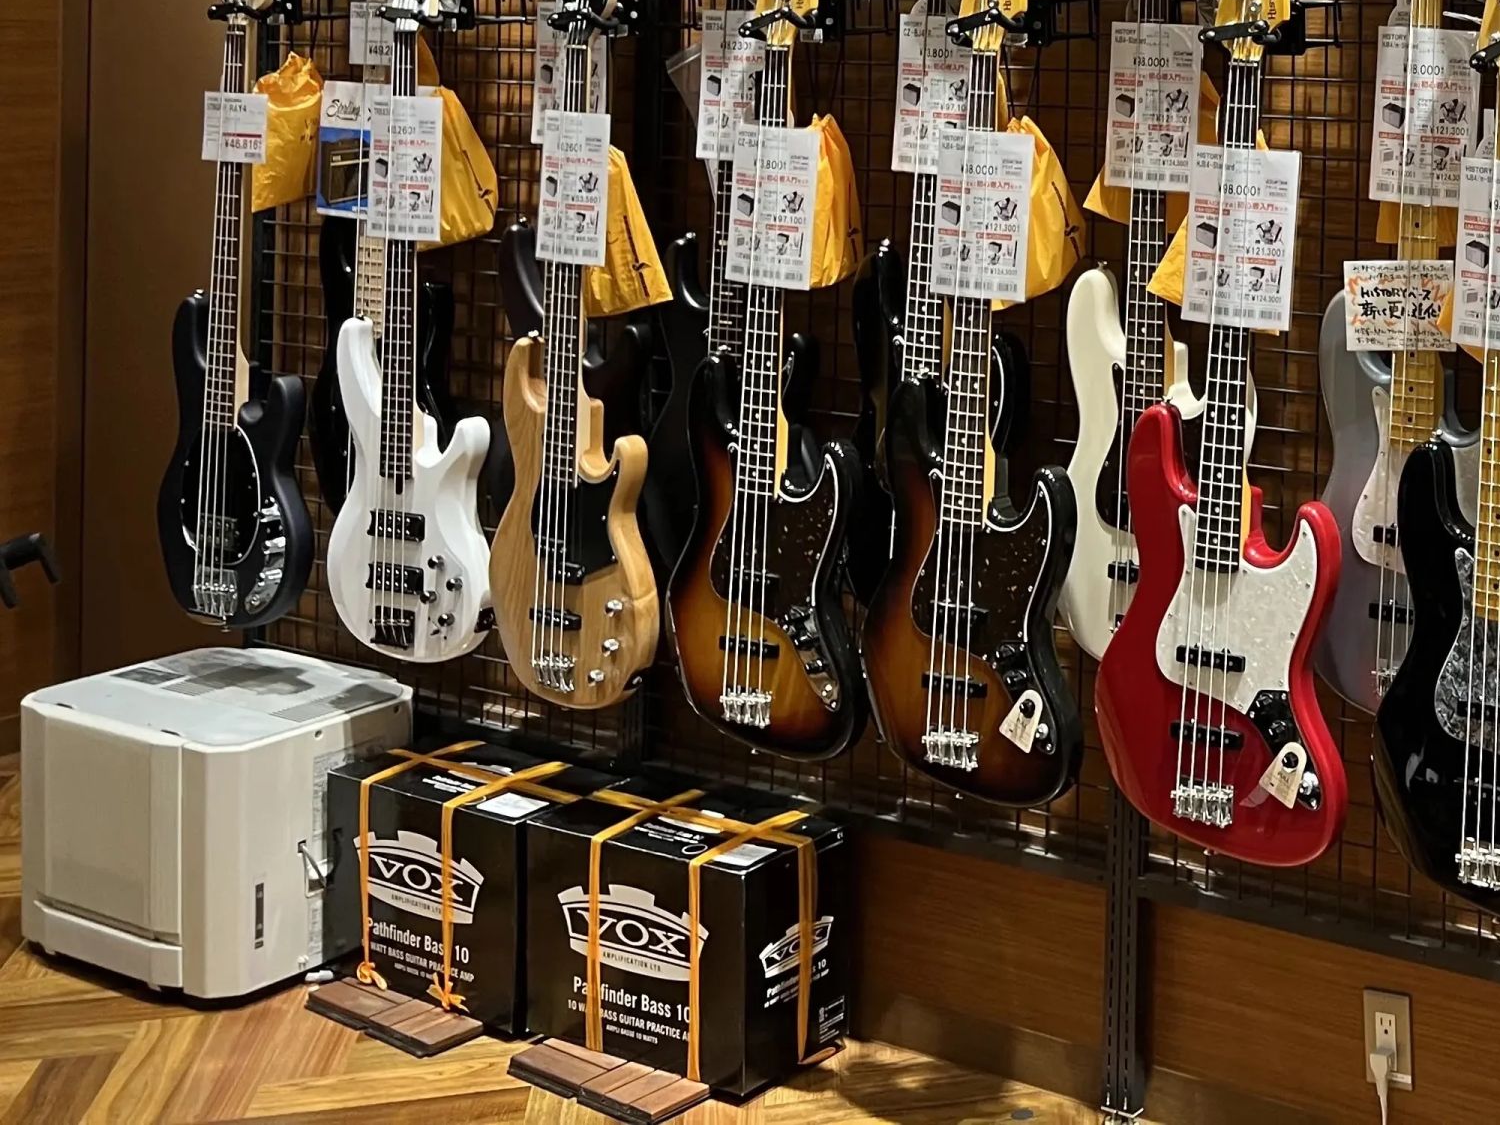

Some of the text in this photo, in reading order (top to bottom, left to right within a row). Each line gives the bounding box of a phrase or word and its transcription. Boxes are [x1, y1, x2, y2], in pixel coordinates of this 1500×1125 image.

[940, 102, 967, 112] ¥97,10
[369, 853, 464, 902] VOX
[367, 916, 470, 964] Pathfinder Bas 10
[576, 909, 687, 958] VOX
[387, 946, 404, 961] BASS
[405, 950, 428, 968] GUITAR
[428, 958, 458, 979] PRACCE
[459, 968, 475, 983] AMP
[602, 951, 648, 969] AMPLIFICATION
[573, 975, 638, 1009] Pafinder
[640, 993, 672, 1018] Bass
[600, 1007, 681, 1041] BASS GUITAR PRACTICE
